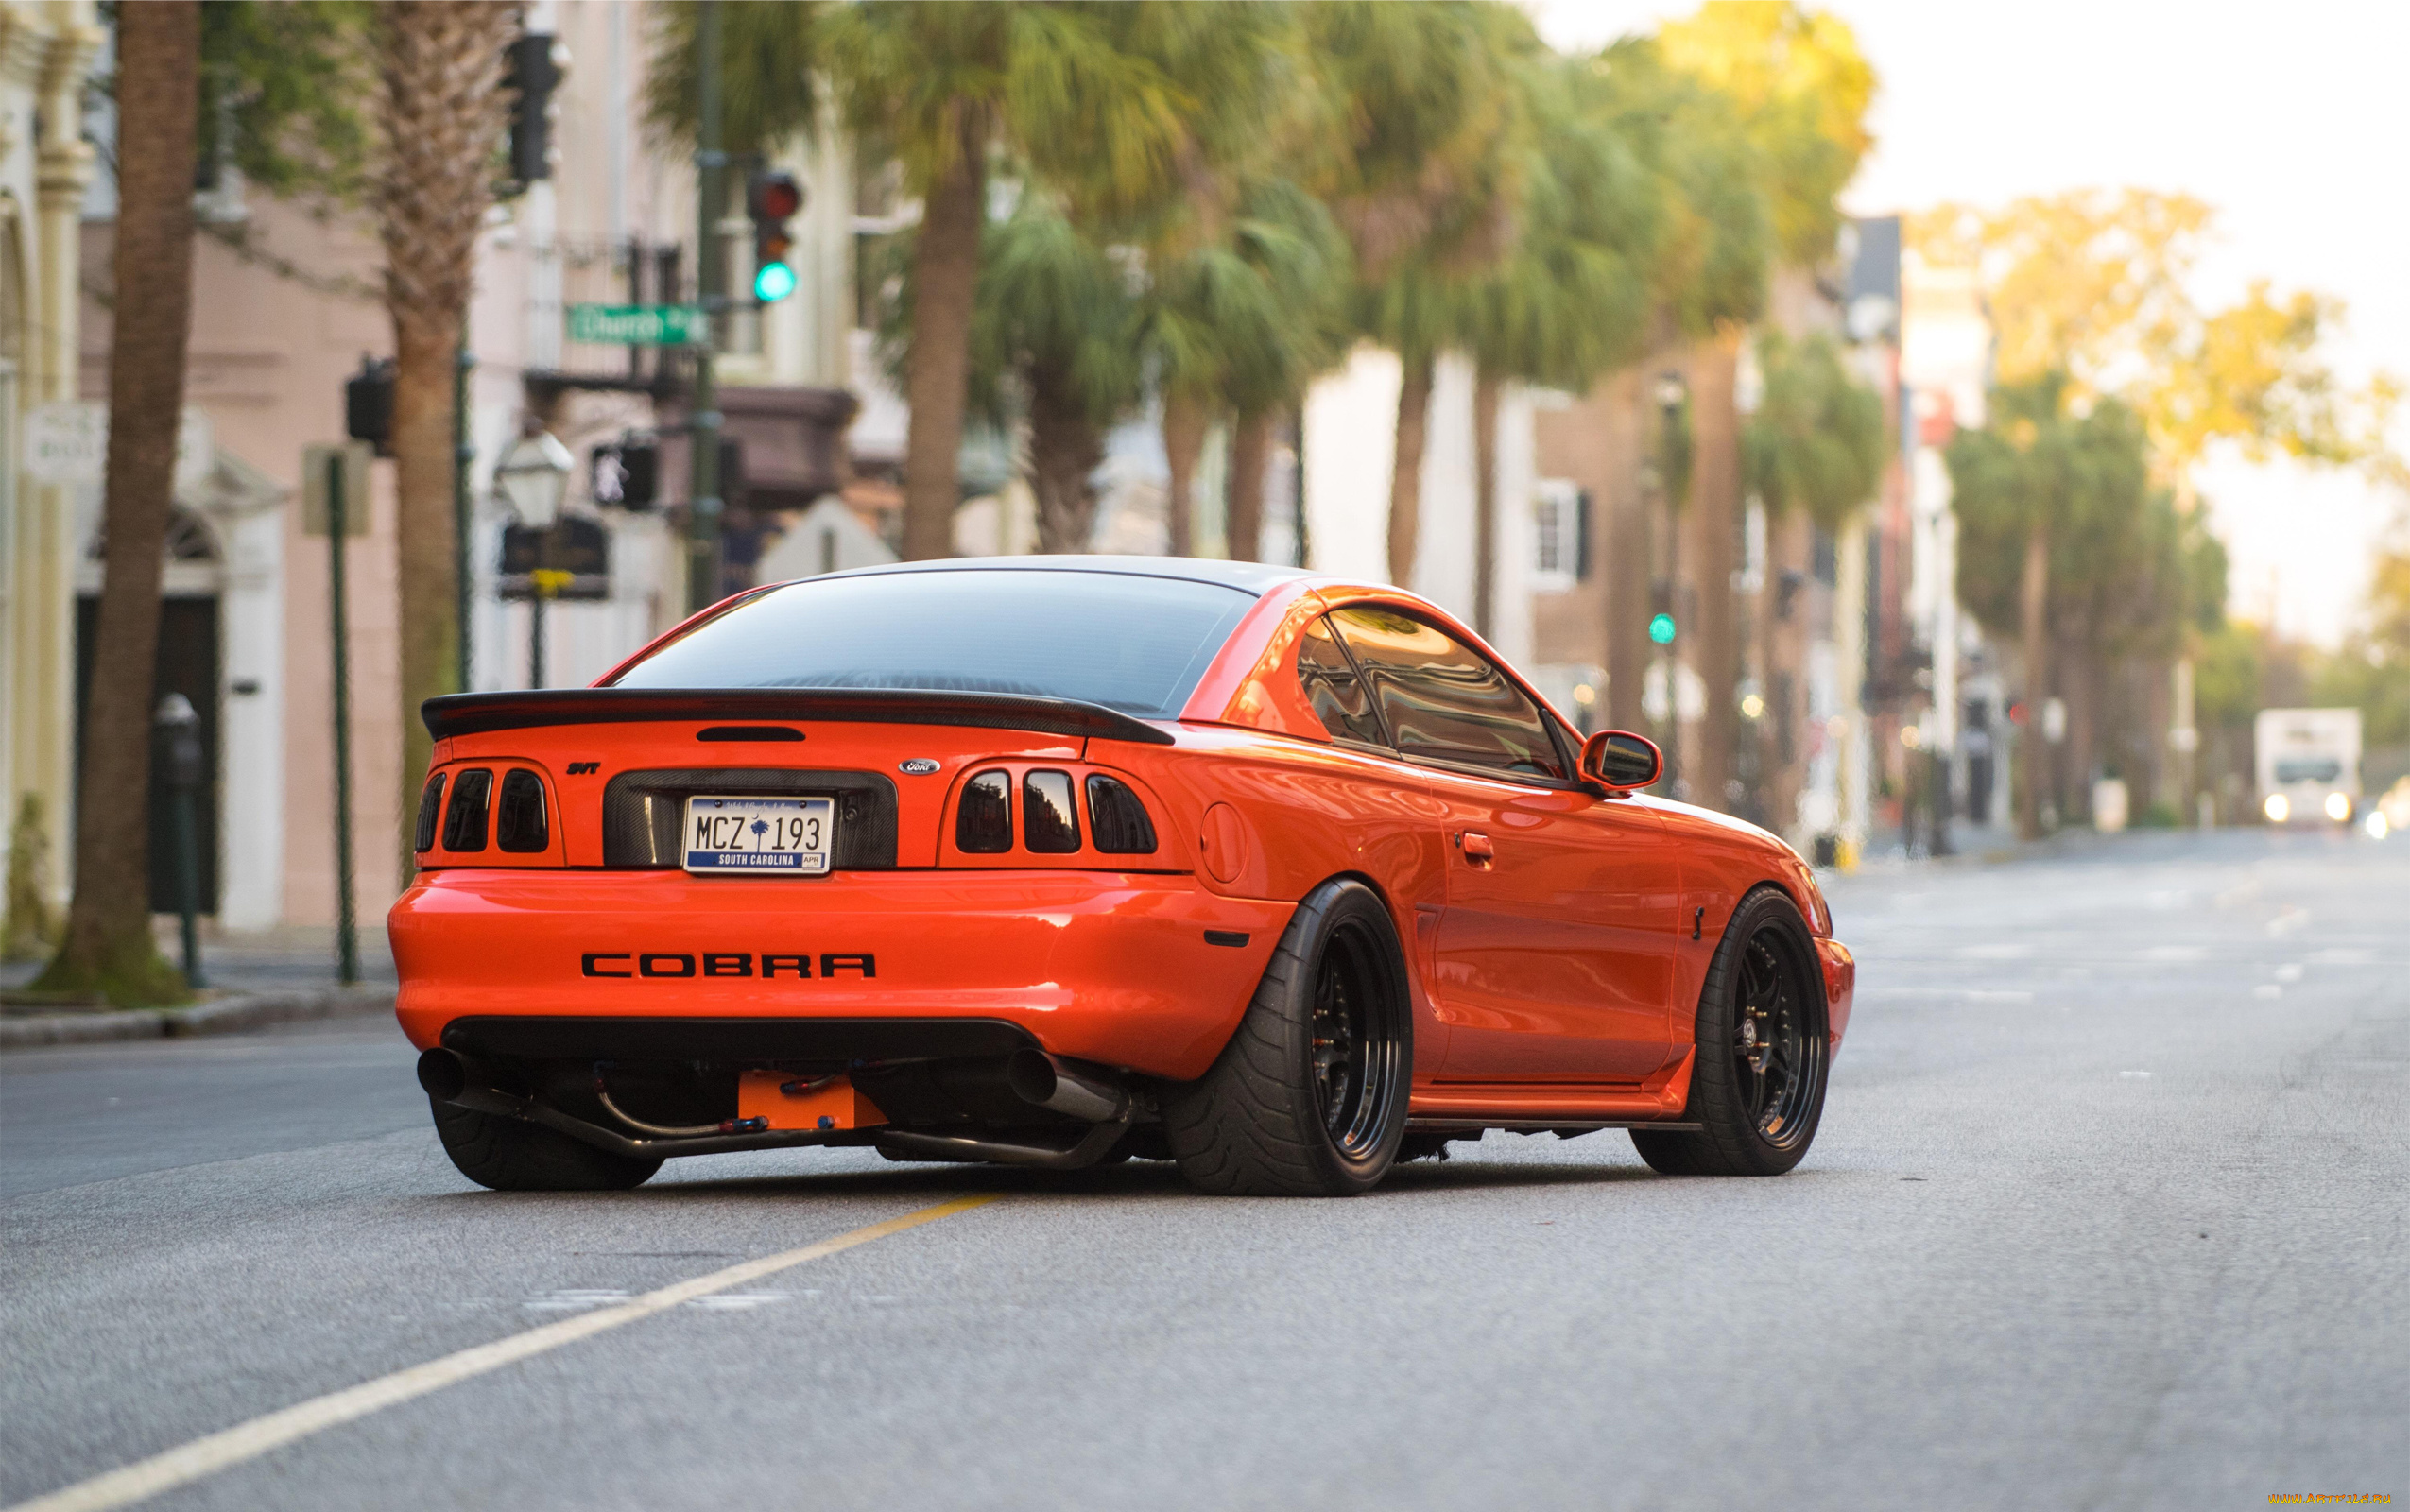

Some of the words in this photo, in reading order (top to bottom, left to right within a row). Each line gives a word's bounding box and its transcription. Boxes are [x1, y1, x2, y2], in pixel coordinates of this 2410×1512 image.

[566, 761, 601, 775] SVT
[906, 762, 931, 771] Ford
[696, 816, 745, 850] MCZ
[772, 817, 820, 850] 193
[718, 854, 748, 865] SOUTH
[750, 854, 794, 866] CAROLINA
[581, 953, 876, 978] COBRA
